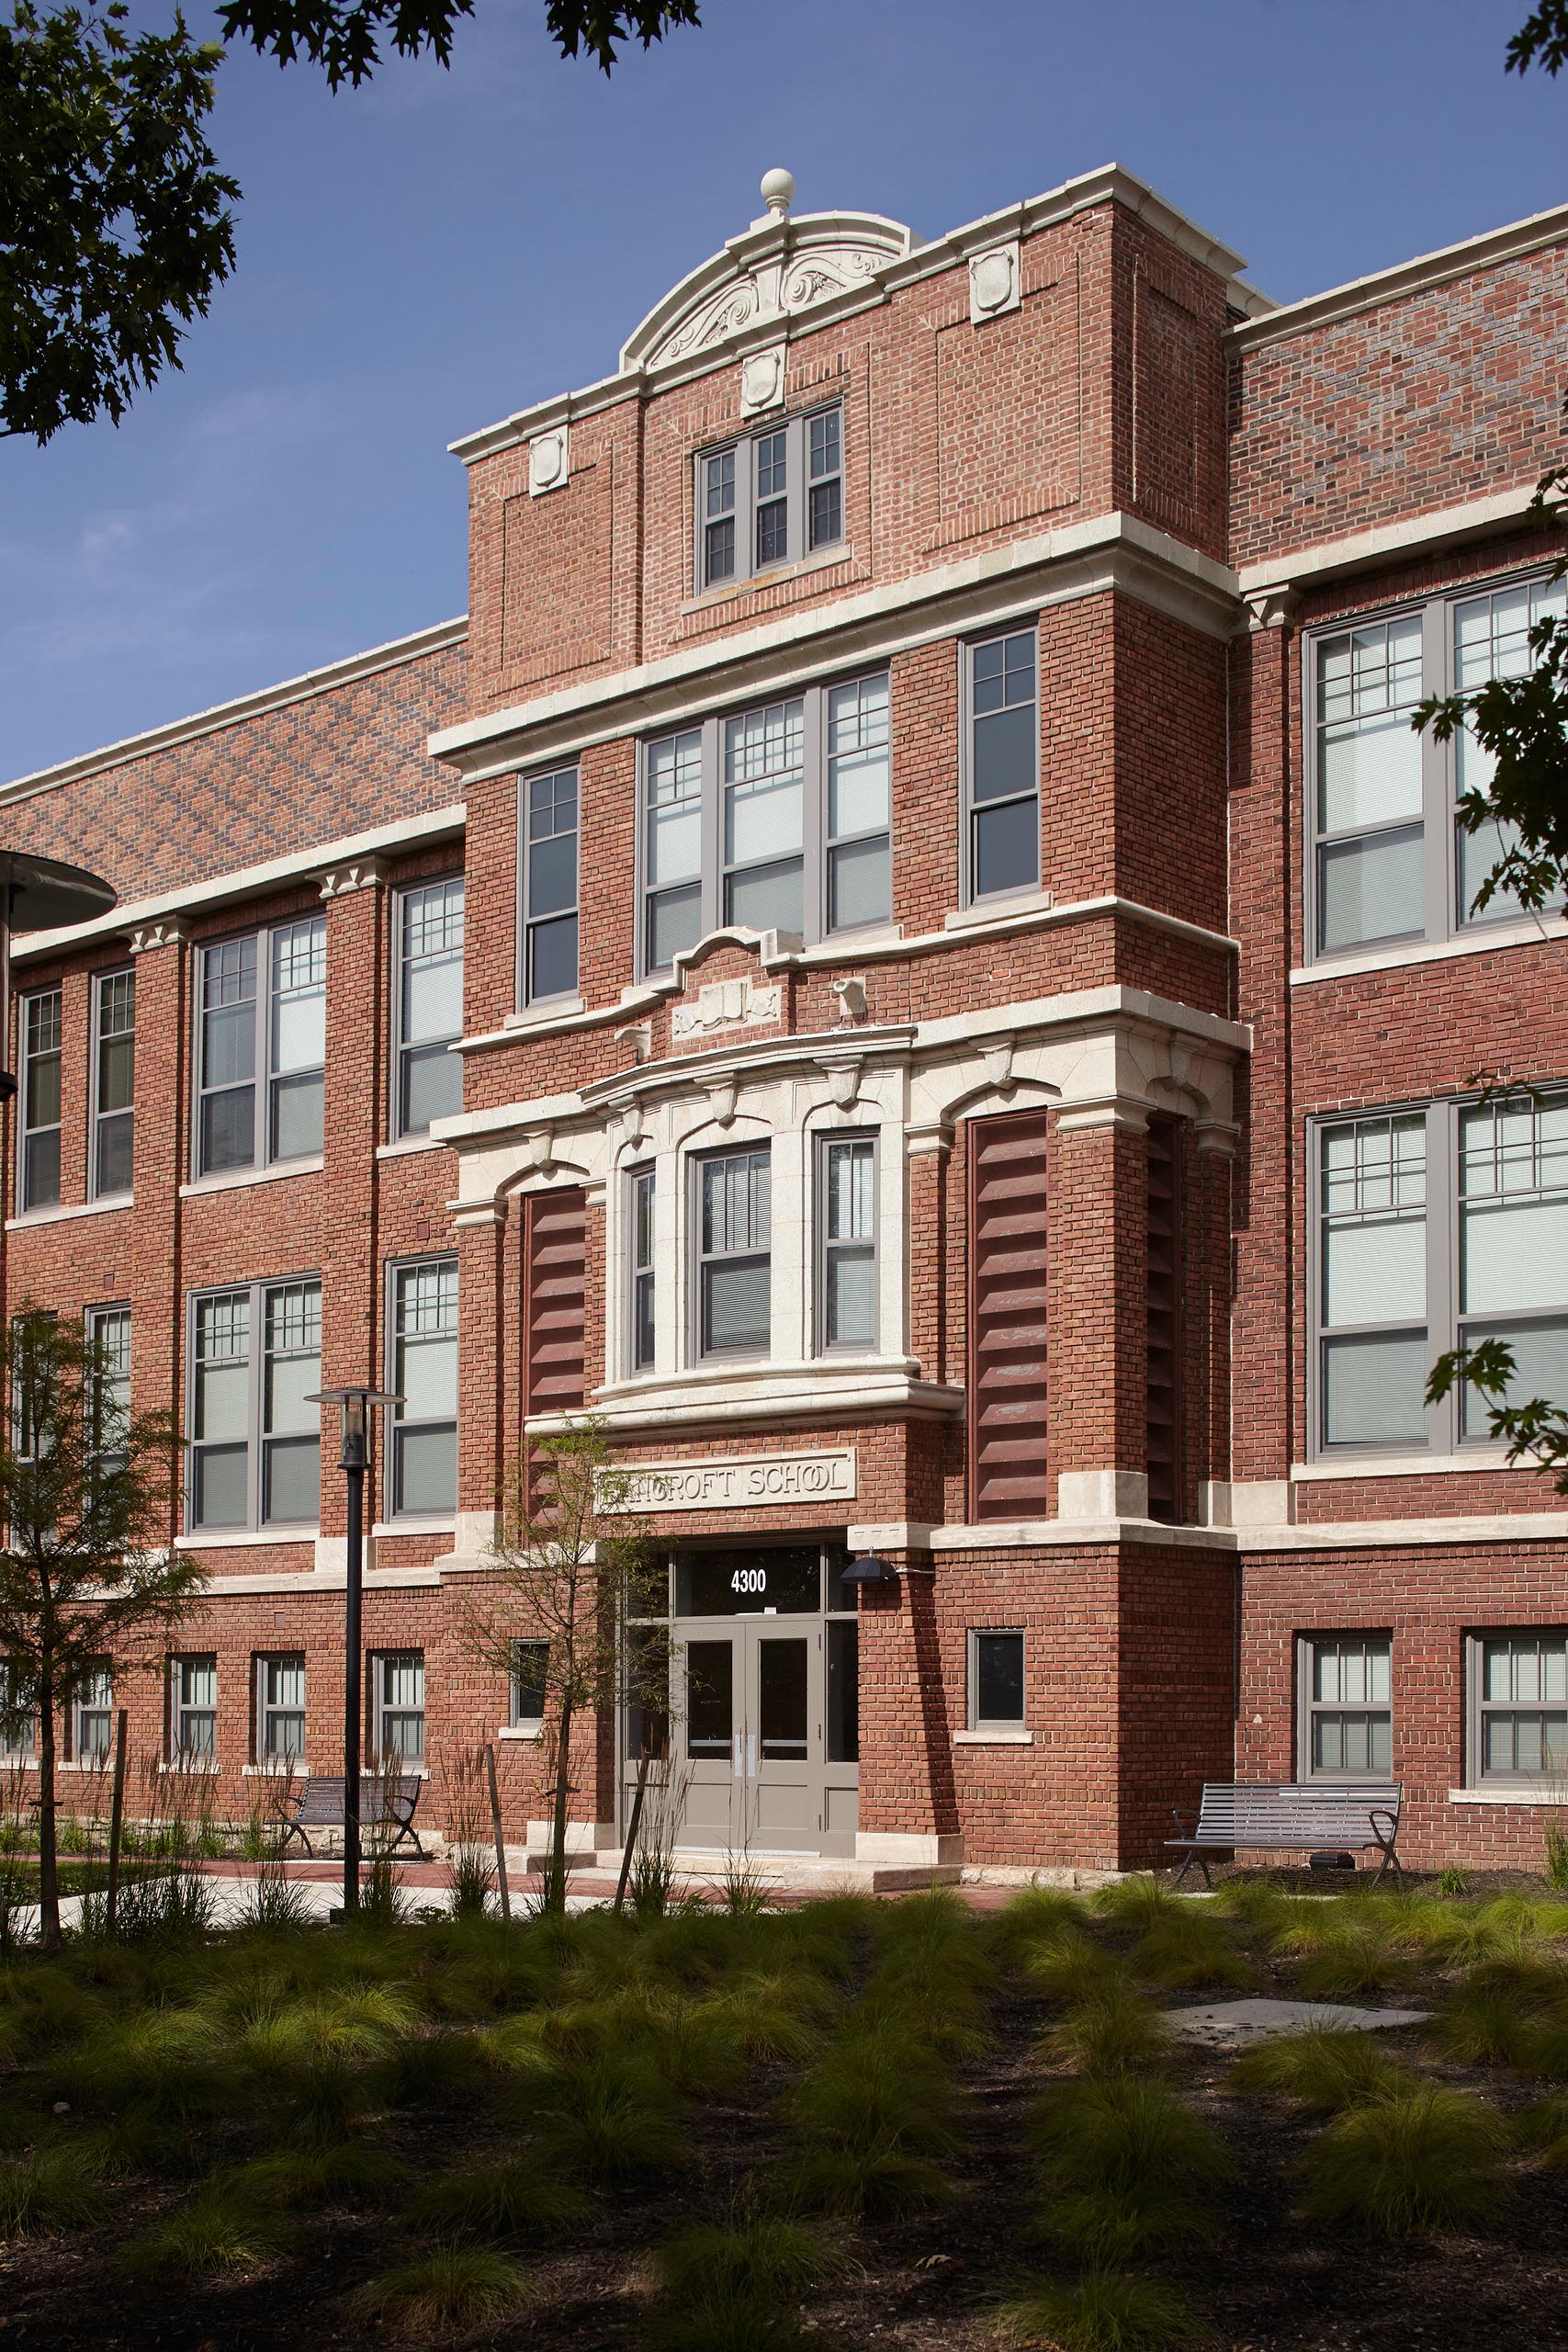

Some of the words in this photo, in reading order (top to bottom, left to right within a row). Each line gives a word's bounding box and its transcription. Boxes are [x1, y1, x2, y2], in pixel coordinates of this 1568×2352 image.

[603, 1469, 736, 1505] NCROFT
[747, 1463, 848, 1496] SCHOOL
[730, 1568, 767, 1593] 4300
